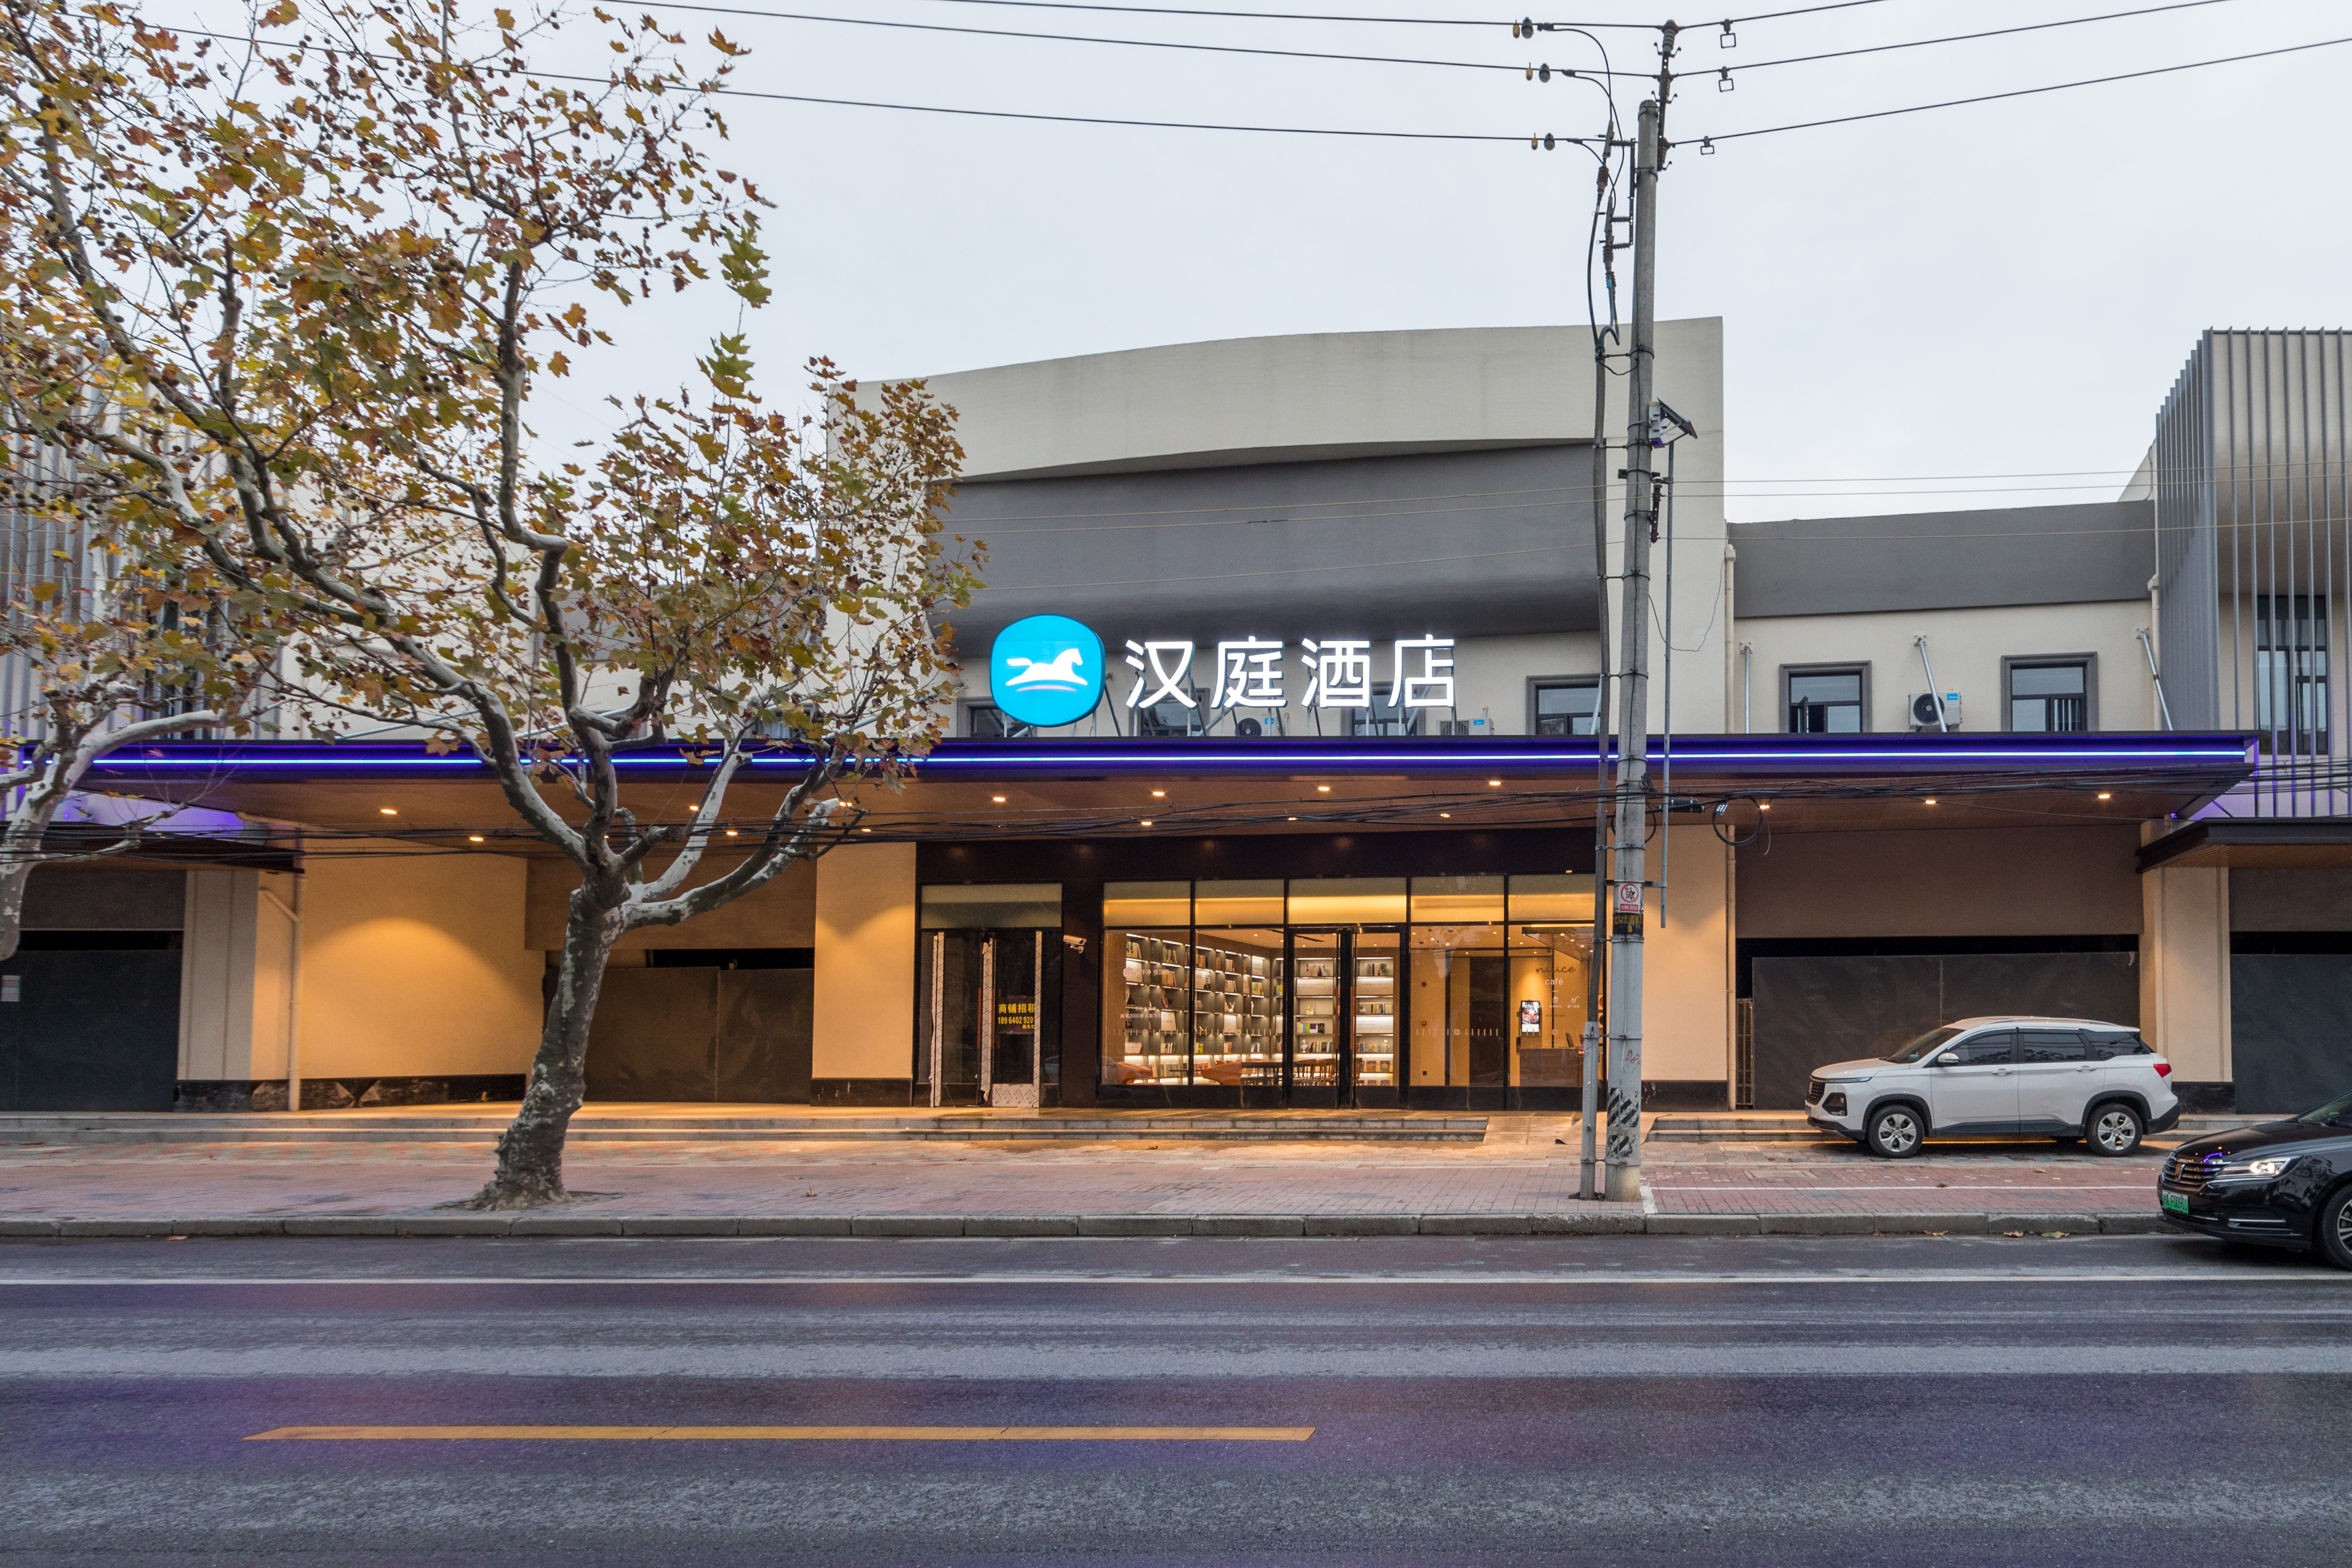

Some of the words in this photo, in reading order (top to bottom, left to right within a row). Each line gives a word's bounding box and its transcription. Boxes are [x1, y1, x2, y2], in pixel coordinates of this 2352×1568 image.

[1126, 634, 1455, 709] 汉庭酒店
[998, 1003, 1035, 1013] 商铺招租
